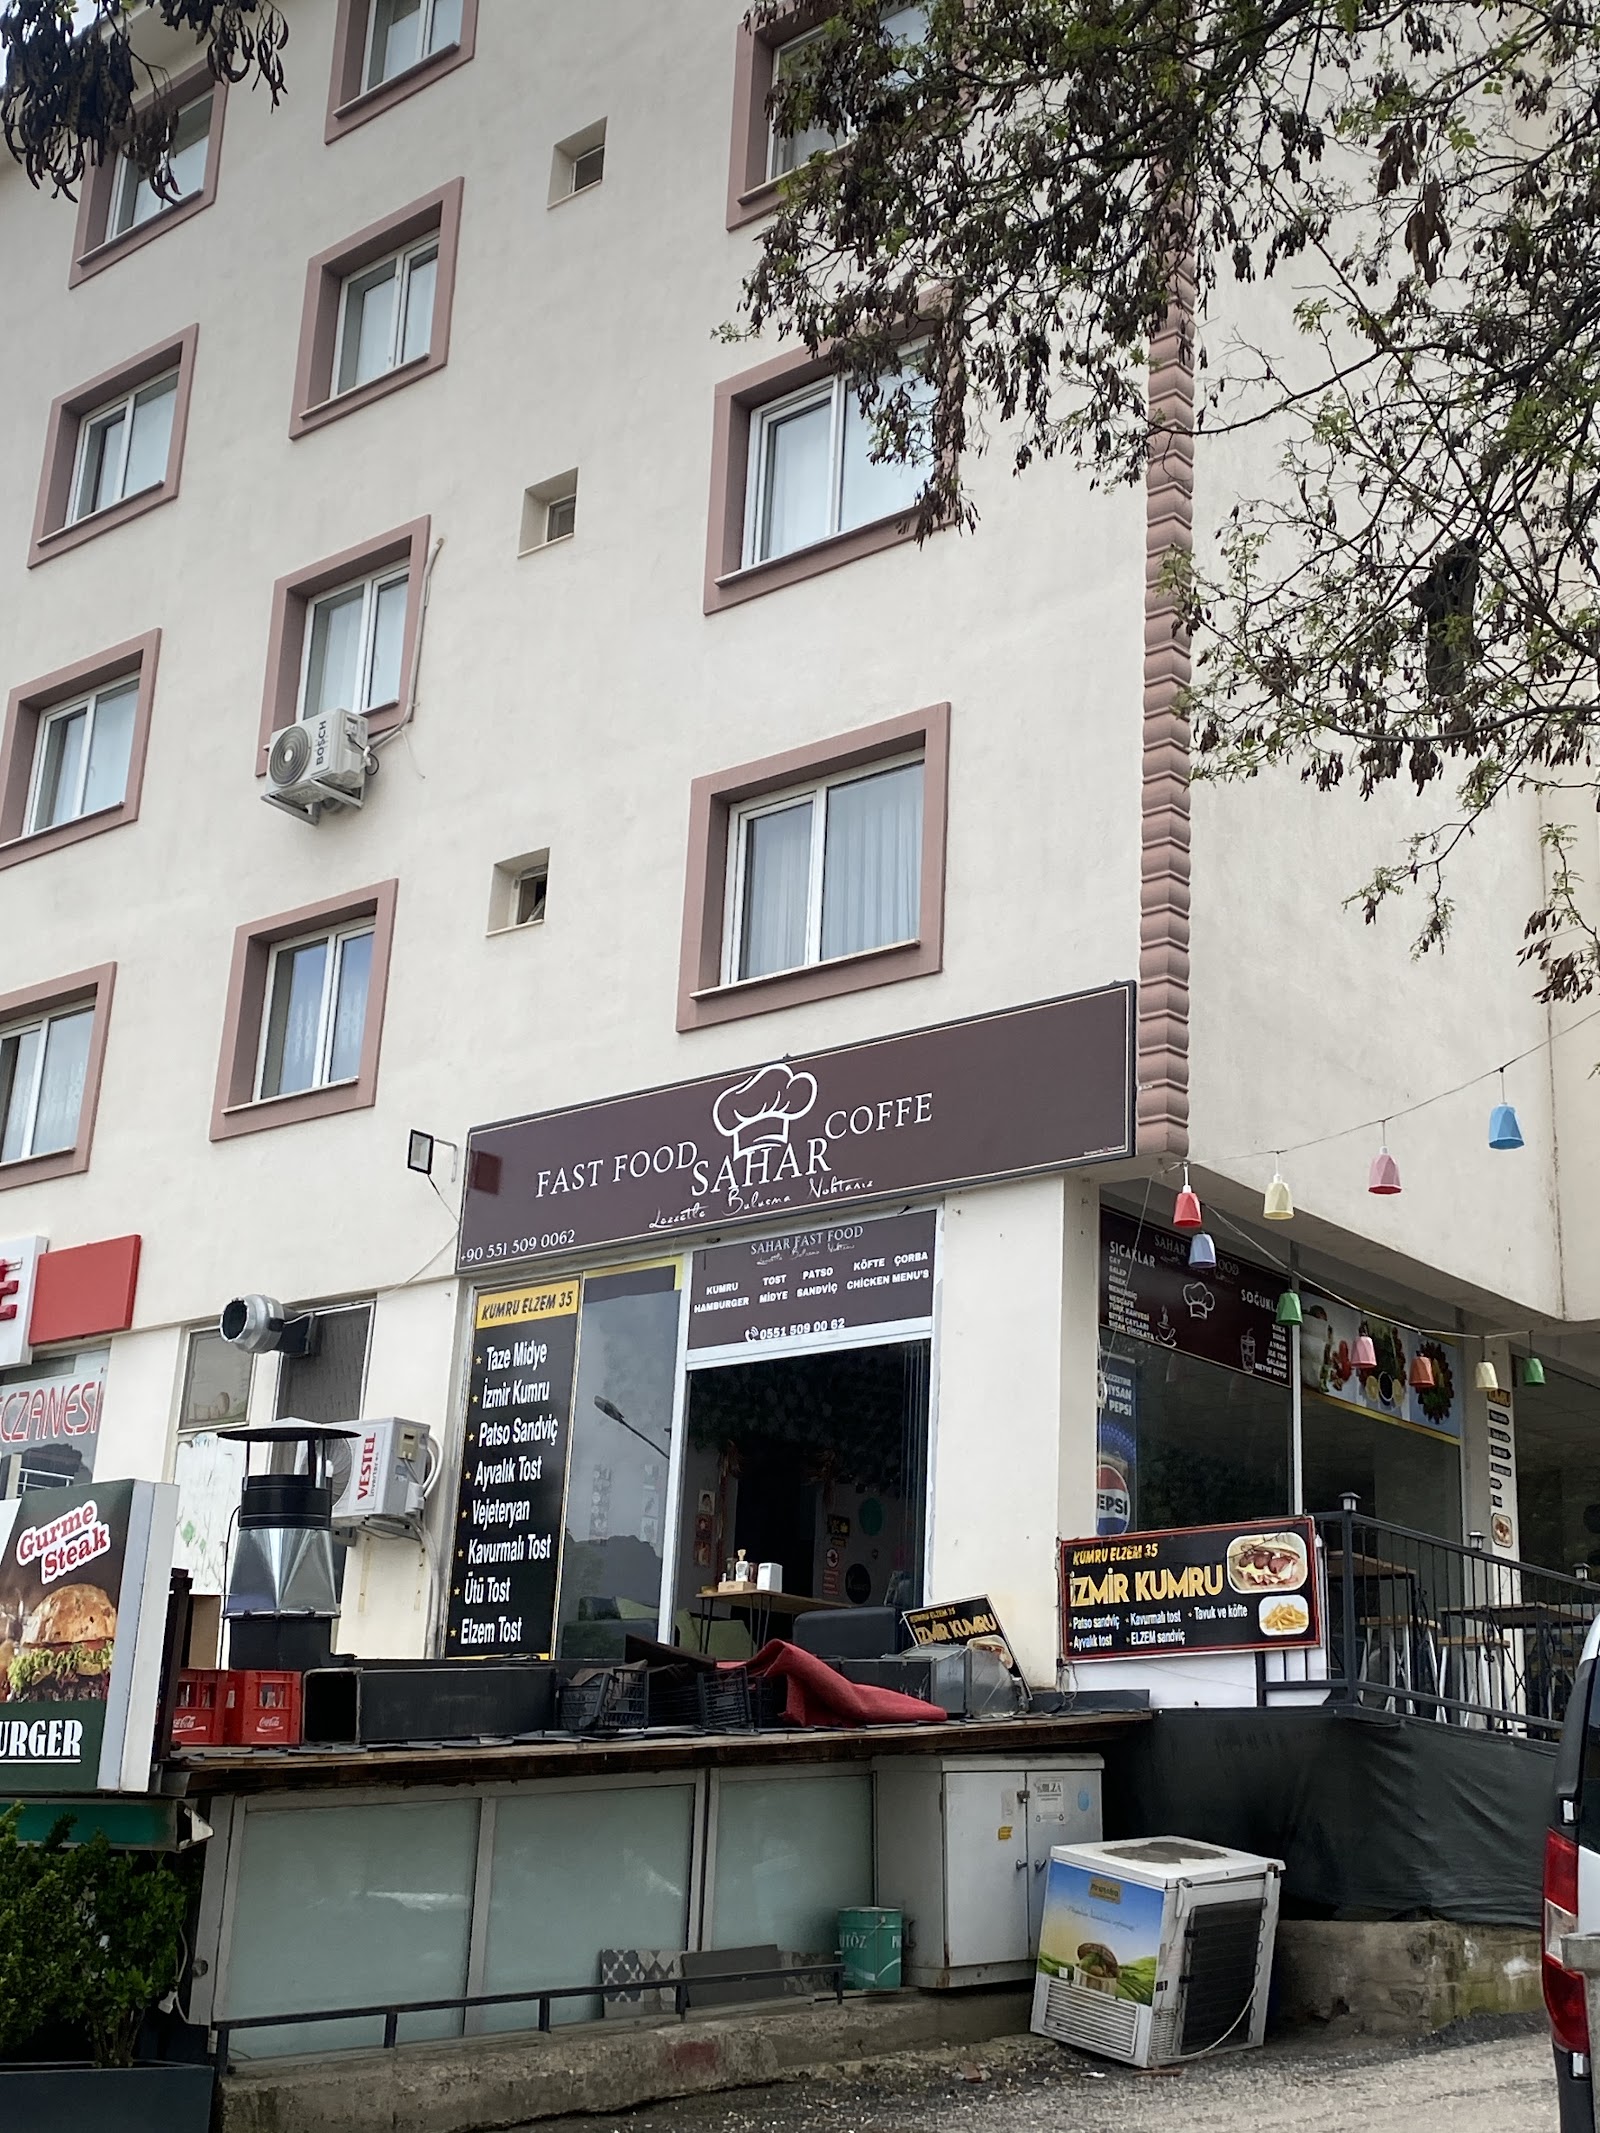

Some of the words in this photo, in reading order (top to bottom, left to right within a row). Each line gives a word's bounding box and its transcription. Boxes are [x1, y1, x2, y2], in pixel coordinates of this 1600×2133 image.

[316, 720, 327, 766] BOSCH
[824, 1092, 933, 1140] COFFE
[535, 1159, 604, 1198] FAST
[612, 1141, 698, 1183] FOOD
[691, 1137, 832, 1196] SAHAR
[486, 1242, 507, 1259] 551
[511, 1236, 537, 1254] 509
[541, 1229, 576, 1248] 0062
[750, 1237, 791, 1255] SAHAR
[793, 1232, 823, 1249] FAST
[827, 1225, 864, 1242] FOOD
[1109, 1241, 1156, 1268] SICAKLAR
[1154, 1234, 1187, 1257] SAHAR
[1217, 1259, 1240, 1276] OOD
[706, 1282, 739, 1296] KUMRU
[762, 1274, 787, 1286] TOST
[802, 1267, 834, 1280] PATSO
[853, 1257, 885, 1271] KÖFTE
[894, 1251, 929, 1267] ÇORBA
[481, 1299, 520, 1321] KUMRU
[521, 1293, 557, 1314] ELZEM
[558, 1290, 574, 1309] 35
[693, 1297, 750, 1314] HAMBURGER
[759, 1290, 789, 1304] MİDYE
[797, 1282, 838, 1298] SANDVİÇ
[1241, 1288, 1278, 1312] SOĞUKL
[759, 1326, 787, 1340] 0551
[790, 1323, 811, 1336] 509
[813, 1319, 828, 1333] 00
[830, 1317, 845, 1330] 62
[486, 1345, 511, 1371] Taze
[512, 1339, 548, 1371] Midye
[482, 1377, 511, 1410] İzmir
[512, 1379, 550, 1405] Kumru
[478, 1421, 511, 1448] Patso
[512, 1413, 559, 1446] Sandviç
[357, 1432, 377, 1500] VESTEL
[474, 1457, 516, 1492] Ayvalık
[518, 1455, 543, 1482] Tost
[472, 1498, 531, 1531] Vejeteryan
[19, 1504, 95, 1560] Gurme
[44, 1526, 108, 1579] Steak
[467, 1534, 525, 1565] Kavurmalı
[527, 1533, 552, 1560] Tost
[1072, 1547, 1108, 1566] KUMRU
[1109, 1544, 1143, 1562] ELZEM
[1144, 1543, 1159, 1559] 35
[464, 1571, 484, 1605] Ütü
[487, 1576, 511, 1603] Tost
[1069, 1567, 1131, 1608] İZMİR
[1134, 1564, 1224, 1602] KUMRU
[948, 1613, 998, 1638] KUMRU
[1072, 1616, 1093, 1630] Patso
[1093, 1613, 1121, 1630] sandviç
[1167, 1609, 1182, 1624] tost
[1194, 1606, 1216, 1621] Tavuk
[1216, 1608, 1227, 1619] ve
[1227, 1603, 1248, 1618] köfte
[460, 1617, 496, 1645] Elzem
[498, 1615, 523, 1642] Tost
[1130, 1630, 1156, 1646] ELZEM
[1156, 1628, 1186, 1646] sandviç
[0, 1719, 83, 1757] URGER
